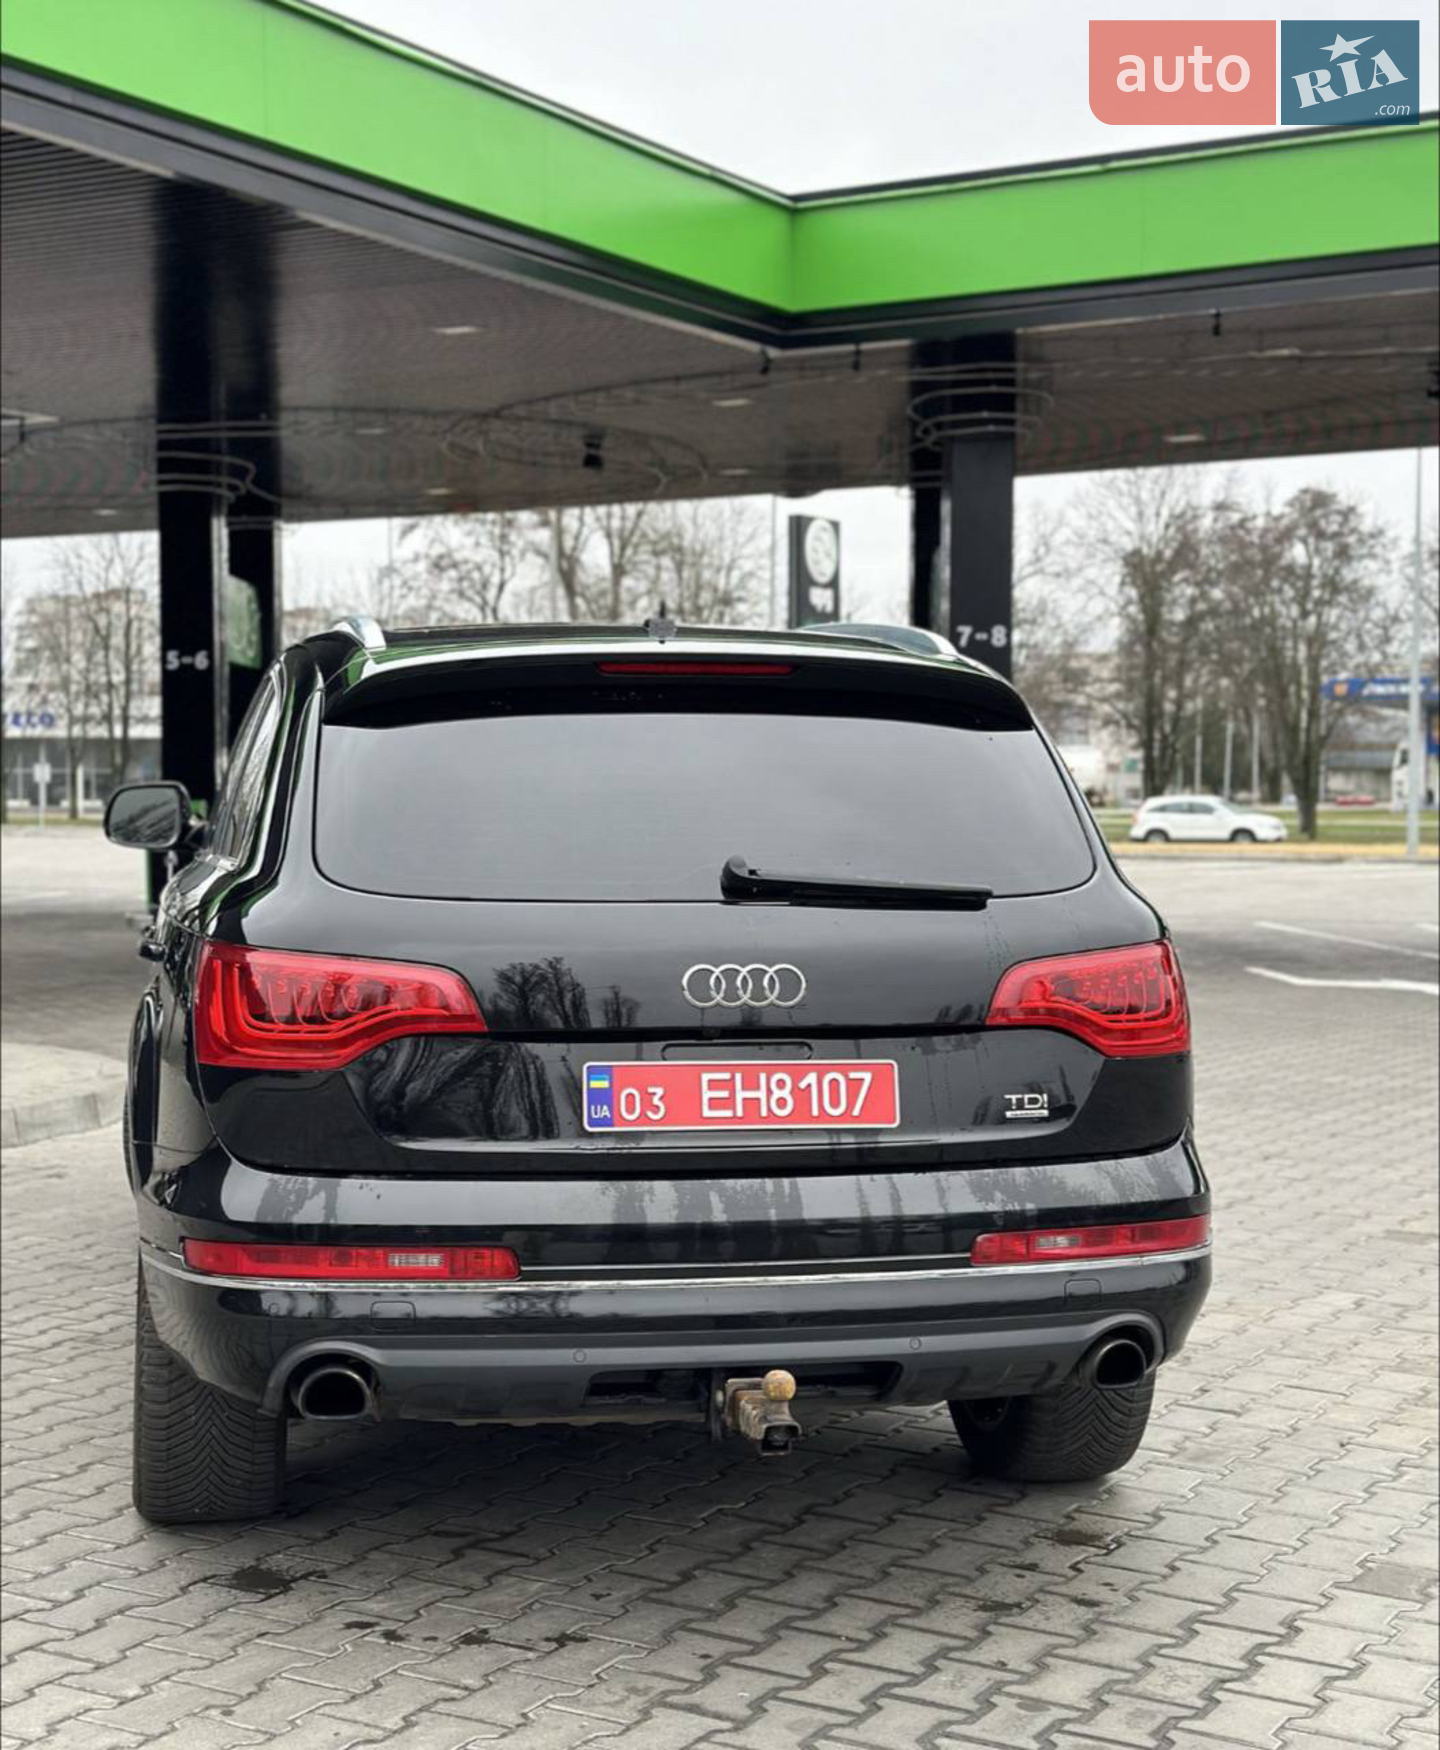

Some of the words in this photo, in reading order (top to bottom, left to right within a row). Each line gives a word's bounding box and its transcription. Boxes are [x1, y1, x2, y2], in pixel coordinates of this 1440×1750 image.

[956, 624, 1007, 648] 7-8
[165, 650, 209, 671] 5-6
[620, 1087, 666, 1121] 03
[700, 1072, 872, 1118] EH8107
[1004, 1093, 1048, 1109] TDI
[591, 1105, 611, 1118] UA
